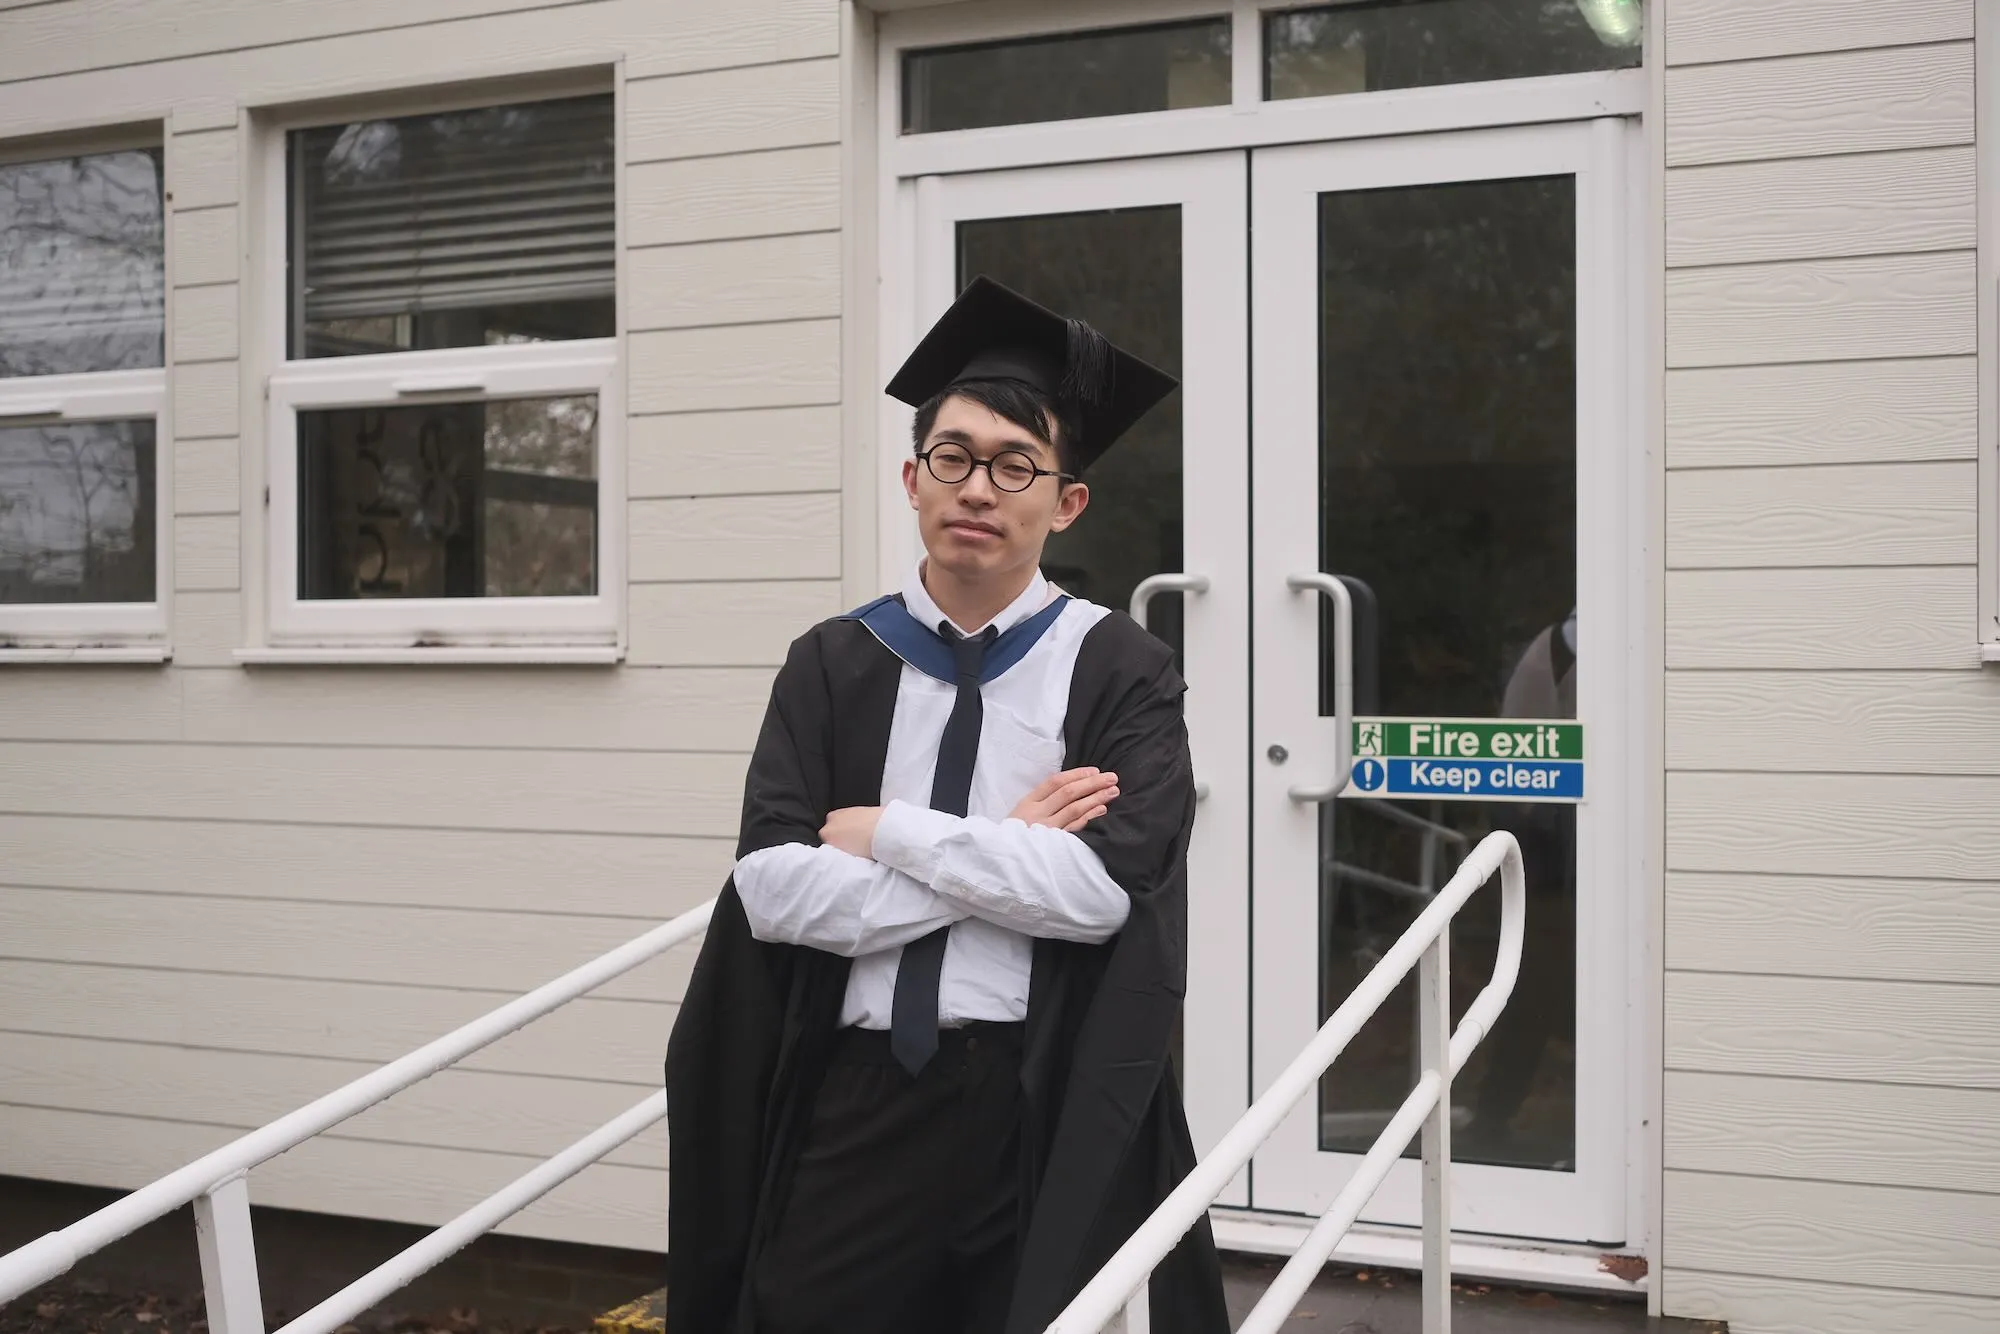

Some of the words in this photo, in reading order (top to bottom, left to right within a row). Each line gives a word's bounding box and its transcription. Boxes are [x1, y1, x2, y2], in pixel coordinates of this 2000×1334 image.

[1409, 724, 1480, 756] Fire
[1490, 726, 1560, 757] exit
[1410, 762, 1481, 792] Keep
[1489, 764, 1561, 788] clear
